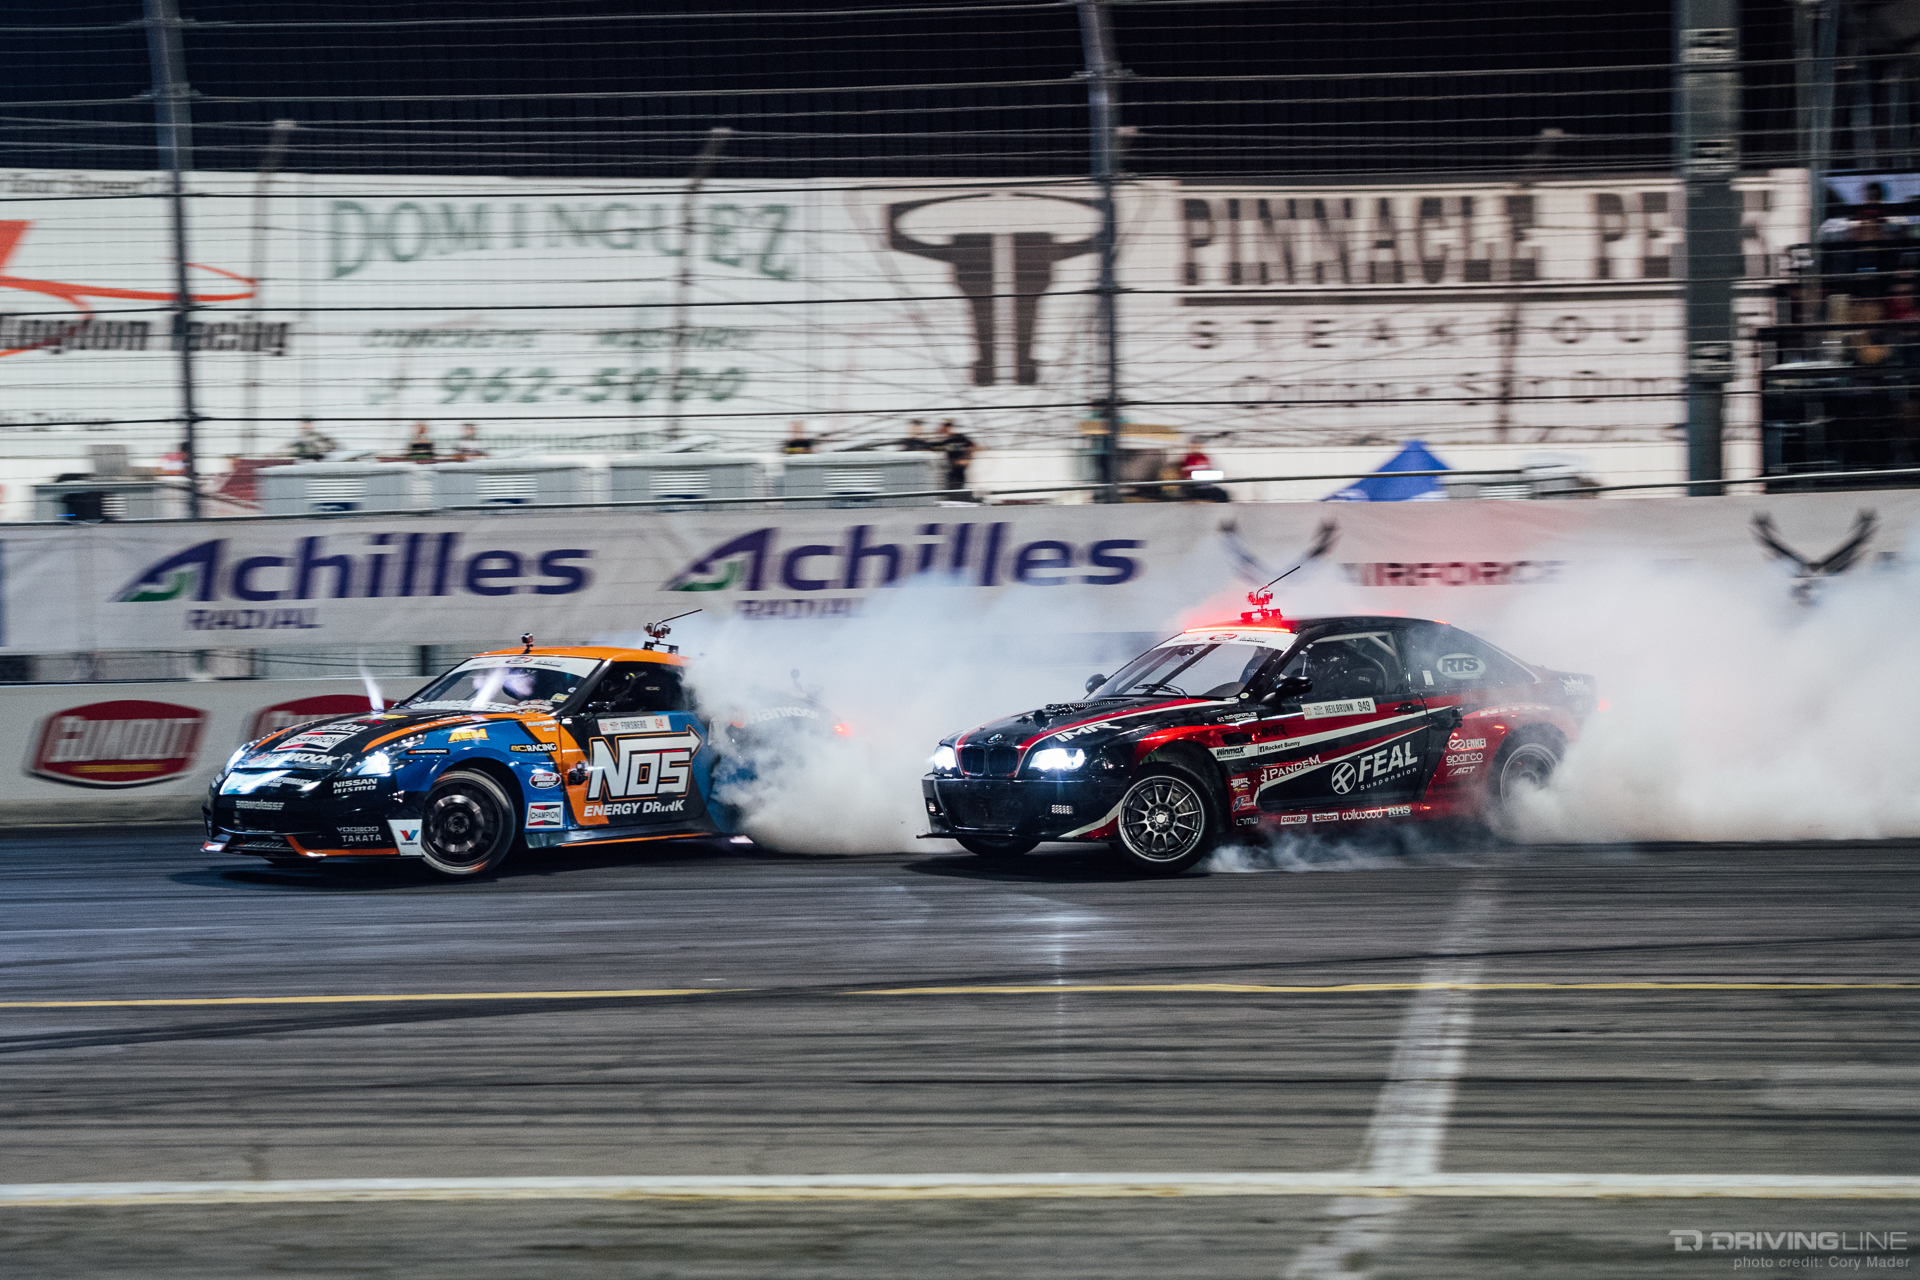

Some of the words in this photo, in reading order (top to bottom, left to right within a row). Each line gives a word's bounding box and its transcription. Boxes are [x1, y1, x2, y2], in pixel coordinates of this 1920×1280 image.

[332, 200, 791, 280] DOMINGUEZ
[1182, 194, 1541, 286] PINNACLE
[664, 522, 1147, 592] Achilles
[112, 531, 595, 603] Achilles
[185, 607, 324, 631] RADIAL
[1442, 657, 1479, 673] RTS
[1324, 703, 1354, 715] HEILBRUNN
[1357, 700, 1371, 712] 949
[447, 728, 489, 743] AEM
[1055, 722, 1122, 743] IMR
[1261, 724, 1289, 738] IMR
[1265, 743, 1284, 752] Rocket
[1284, 740, 1301, 748] Bunny
[1465, 738, 1487, 749] ENKEI
[586, 727, 704, 803] NOS
[1358, 741, 1418, 783] FEAL
[1446, 752, 1484, 766] sparco
[1269, 755, 1321, 781] PANDEM
[333, 778, 378, 789] NISSAN
[1360, 767, 1417, 791] Suspension
[530, 811, 559, 820] CHAMPION
[584, 802, 640, 818] ENERGY
[1342, 808, 1383, 821] wilwood
[1387, 805, 1411, 815] RHS
[1281, 815, 1301, 824] COMP
[1313, 814, 1339, 822] tilton
[341, 834, 382, 843] TAKATA
